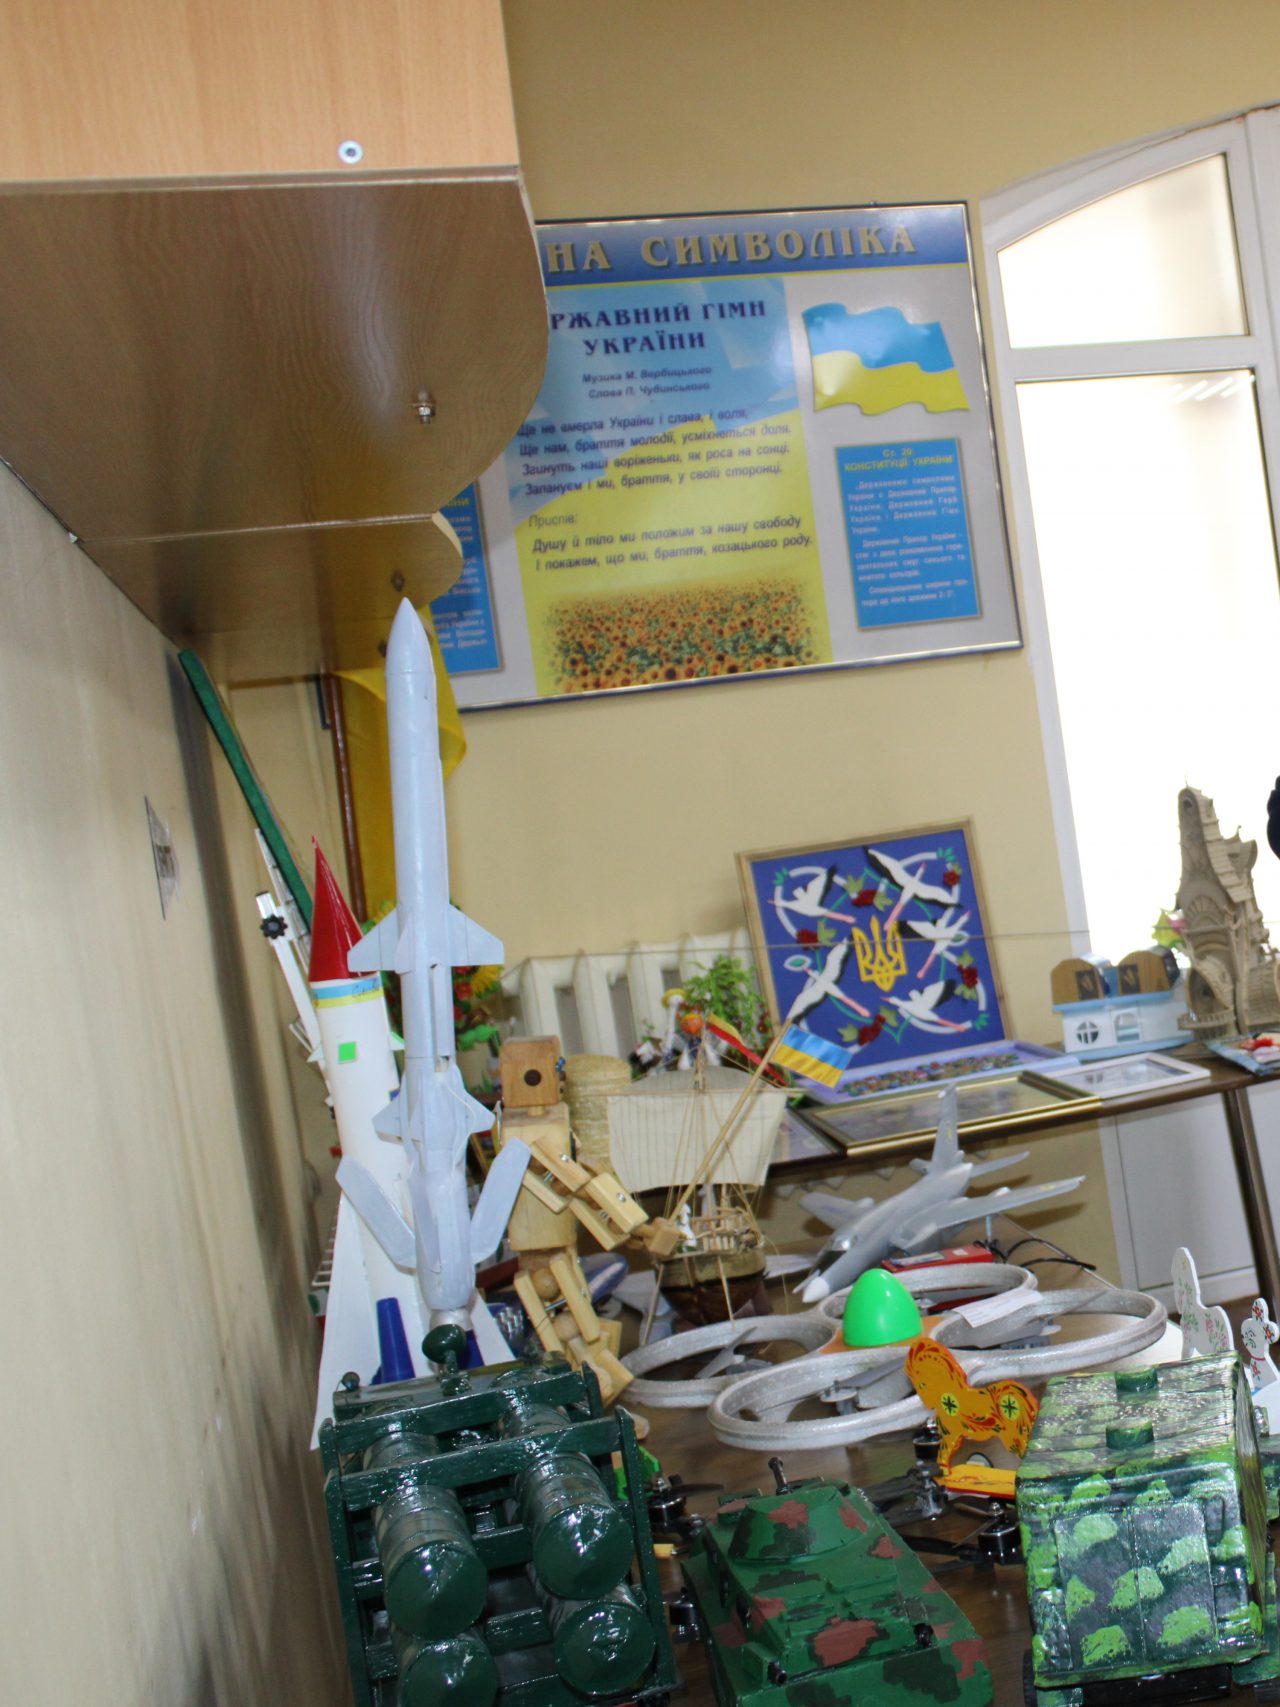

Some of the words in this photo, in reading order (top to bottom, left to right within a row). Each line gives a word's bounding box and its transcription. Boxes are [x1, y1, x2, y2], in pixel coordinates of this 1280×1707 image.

[545, 240, 611, 273] НА
[641, 225, 918, 268] СИМВОЛІКА
[551, 304, 691, 330] РЖАВНИЙ
[703, 301, 766, 320] ГІМН
[583, 330, 706, 356] УКРАЇНИ
[582, 372, 622, 384] Музика
[640, 366, 712, 382] Вербицького
[588, 388, 622, 399] Слова
[542, 425, 556, 434] не
[561, 420, 604, 434] вмерла
[609, 415, 654, 429] України
[519, 443, 538, 457] Ще
[575, 439, 625, 453] браття
[682, 427, 756, 445] усміхнеться
[523, 462, 576, 476] Згинуть
[581, 459, 608, 470] наші
[688, 451, 701, 461] як
[706, 448, 733, 462] роса
[738, 447, 751, 457] на
[525, 482, 583, 496] Запануєм
[678, 472, 684, 485] у
[690, 466, 720, 481] своїй
[528, 513, 578, 529] Приспів:
[532, 538, 566, 555] Душу
[572, 537, 579, 547] й
[585, 534, 614, 546] тіло
[620, 533, 636, 543] ми
[641, 526, 695, 542] положим
[700, 525, 712, 536] за
[718, 522, 748, 537] нашу
[753, 514, 802, 532] свободу
[545, 555, 600, 571] покажем,
[606, 554, 625, 566] що
[712, 538, 778, 555] козацького
[783, 533, 813, 549] роду.
